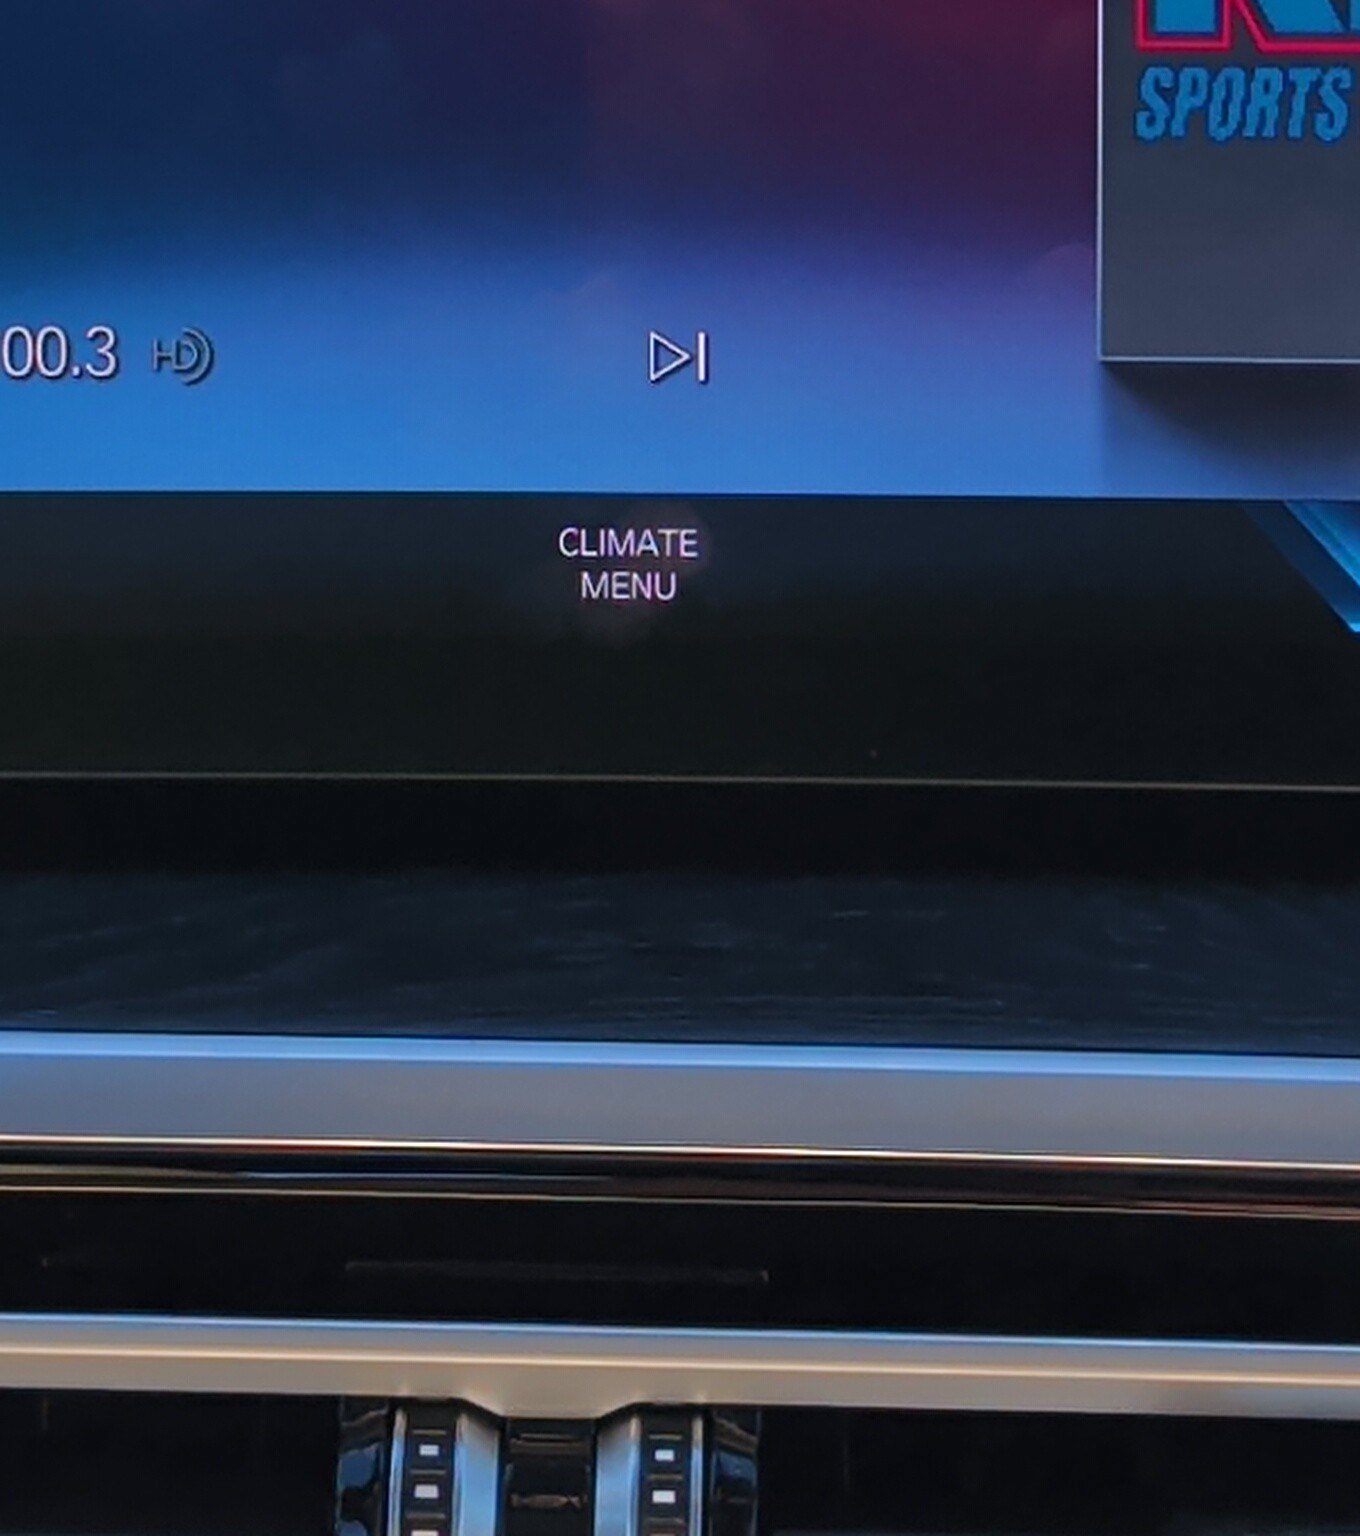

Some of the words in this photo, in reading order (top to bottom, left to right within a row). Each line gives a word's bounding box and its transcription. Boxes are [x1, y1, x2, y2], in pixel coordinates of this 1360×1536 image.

[1134, 65, 1352, 142] SPORTS
[558, 527, 699, 557] CLIMATE
[580, 570, 677, 601] MENU
